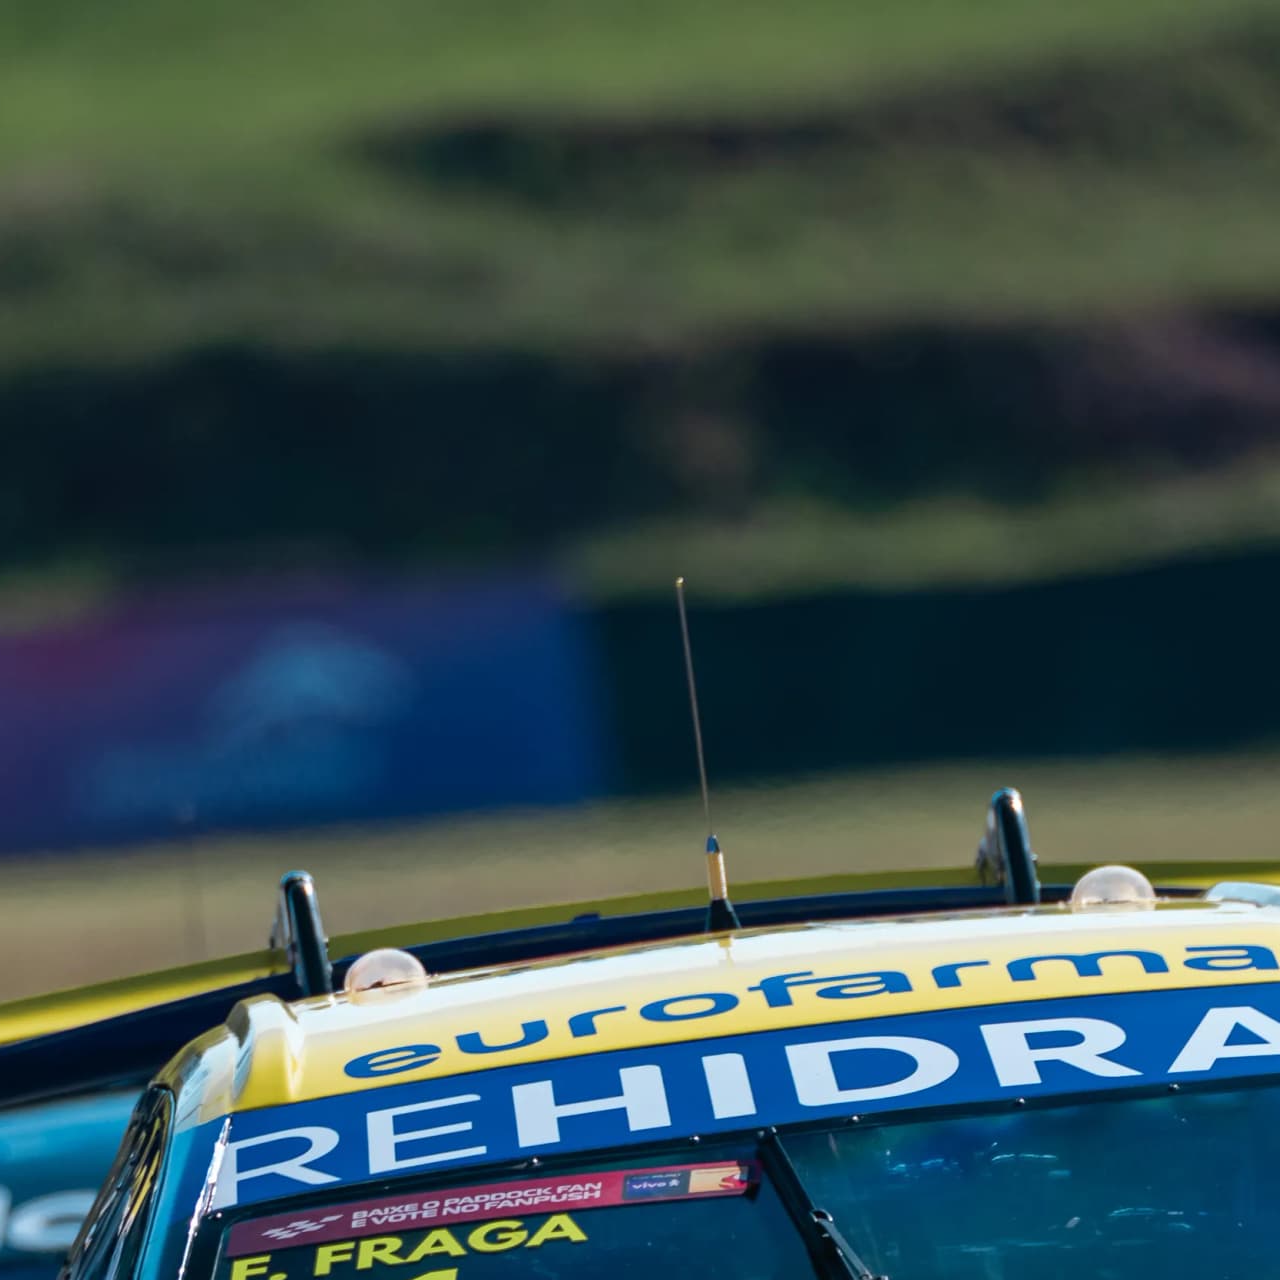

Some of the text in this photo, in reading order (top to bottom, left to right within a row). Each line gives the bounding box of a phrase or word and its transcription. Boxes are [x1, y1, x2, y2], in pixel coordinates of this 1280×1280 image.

[344, 943, 1280, 1079] eurofarma
[351, 1181, 602, 1220] BAIXE O PADDOCK FAN
[351, 1190, 602, 1229] E VOTE NO FANPUSH
[314, 1213, 588, 1277] FRAGA
